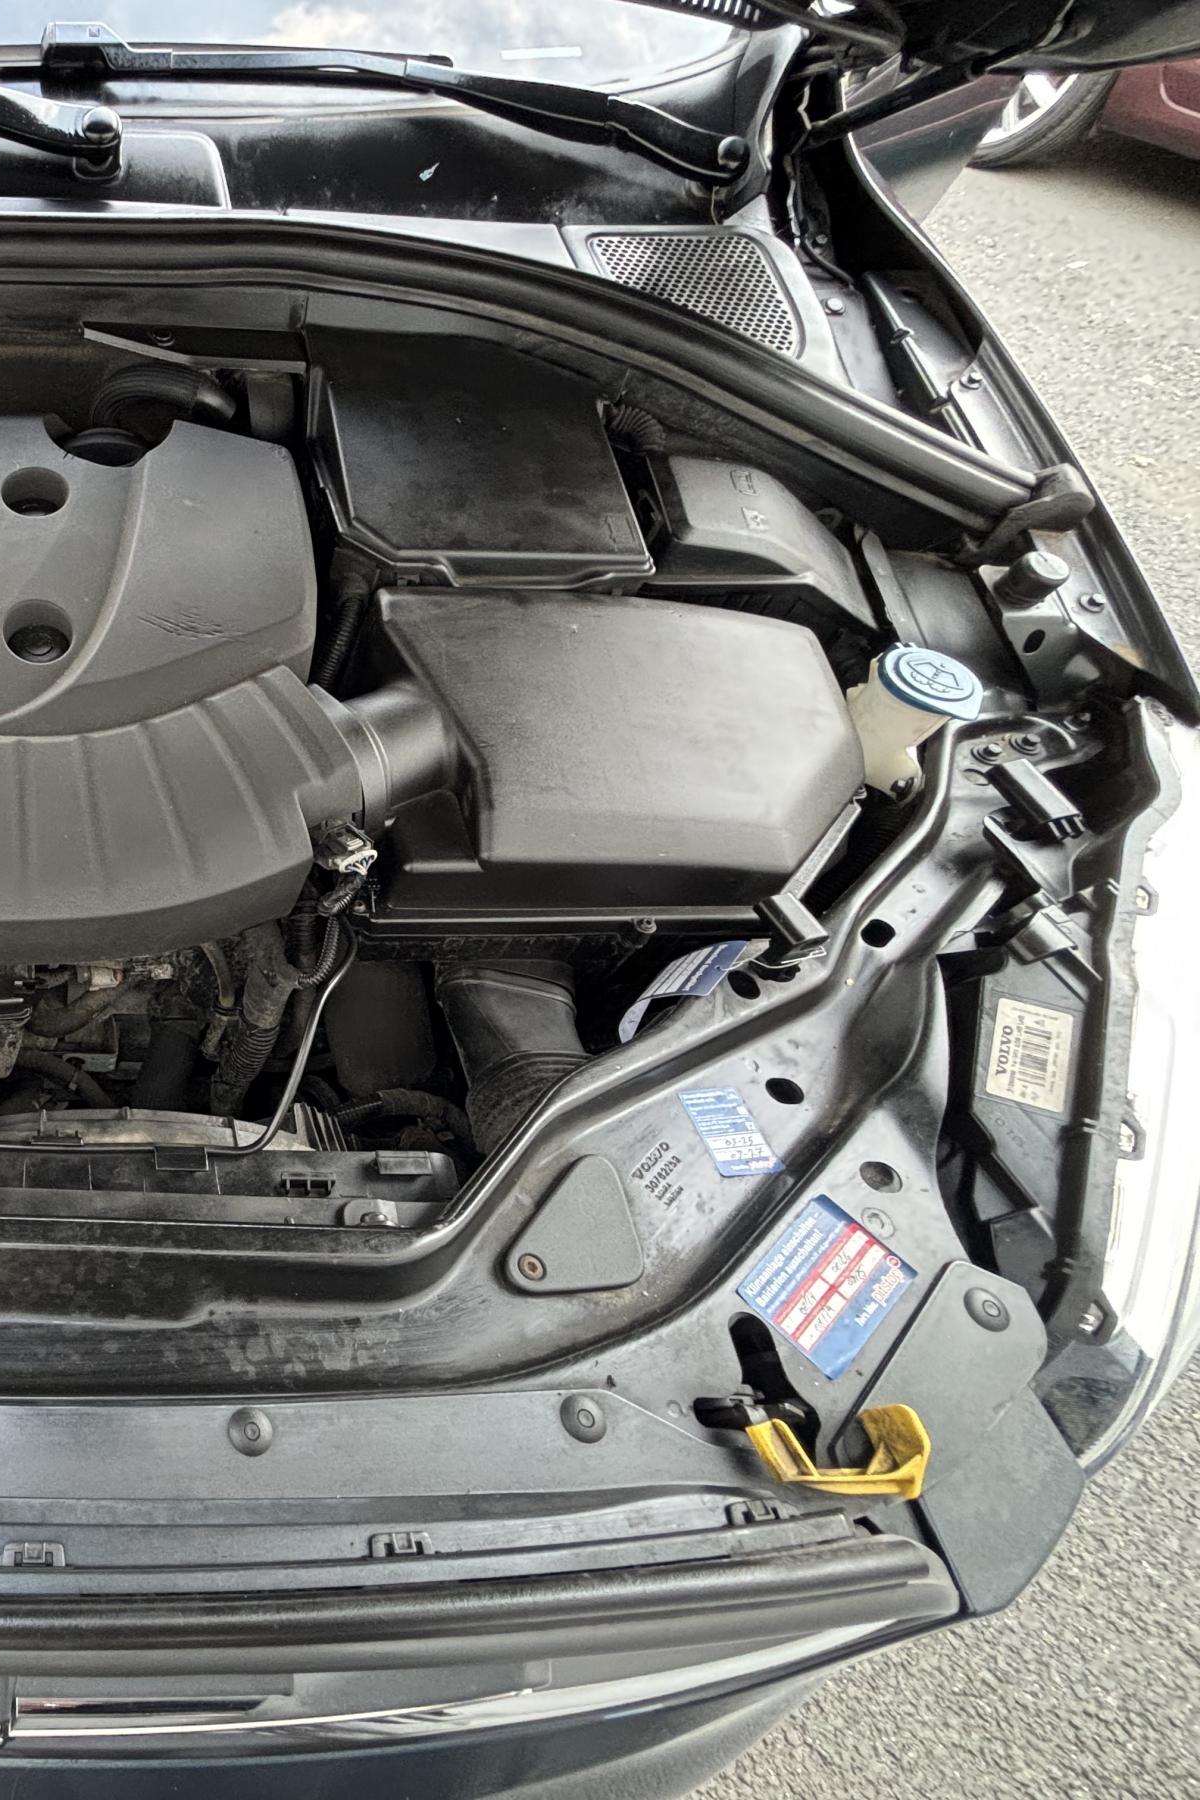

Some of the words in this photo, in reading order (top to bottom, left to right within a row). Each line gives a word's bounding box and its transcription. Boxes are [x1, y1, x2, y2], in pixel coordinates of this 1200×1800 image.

[995, 1025, 1013, 1076] VOLVO
[631, 1141, 670, 1180] VOLVO
[745, 1252, 785, 1297] Klimaanlage
[780, 1216, 816, 1256] einschalten
[755, 1271, 789, 1307] Bakterien
[784, 1228, 824, 1274] ausschalten!
[870, 1267, 906, 1307] pitstop
